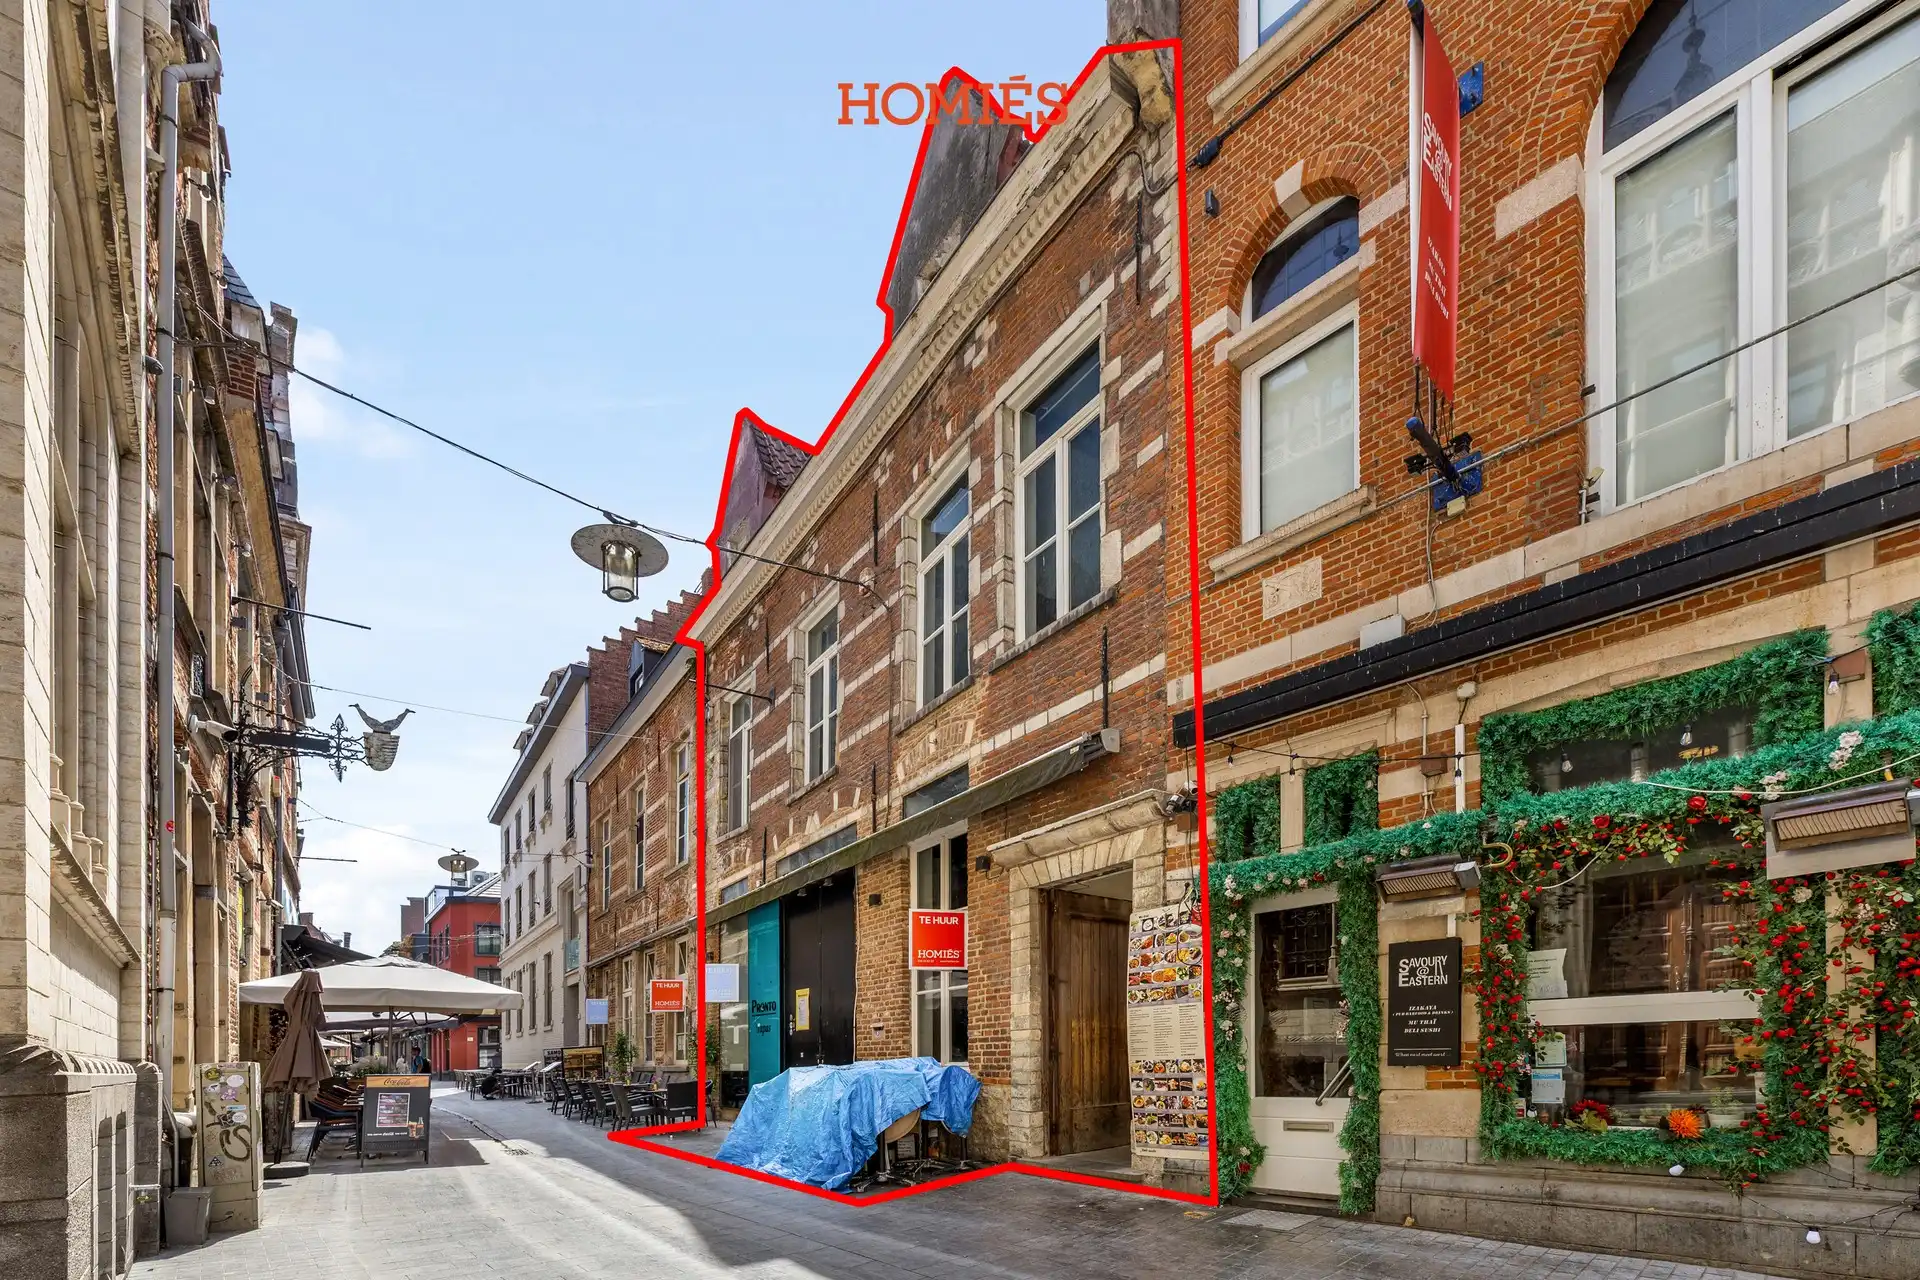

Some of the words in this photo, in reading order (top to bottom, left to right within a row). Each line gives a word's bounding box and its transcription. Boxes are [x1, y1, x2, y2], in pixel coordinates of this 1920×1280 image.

[919, 915, 931, 925] TE
[932, 916, 959, 925] HUUR
[917, 948, 960, 959] HOMIÉS
[1399, 955, 1448, 976] SAVOURY
[1416, 966, 1430, 977] @
[1399, 973, 1448, 987] EASTERN
[751, 999, 777, 1014] PRONTO
